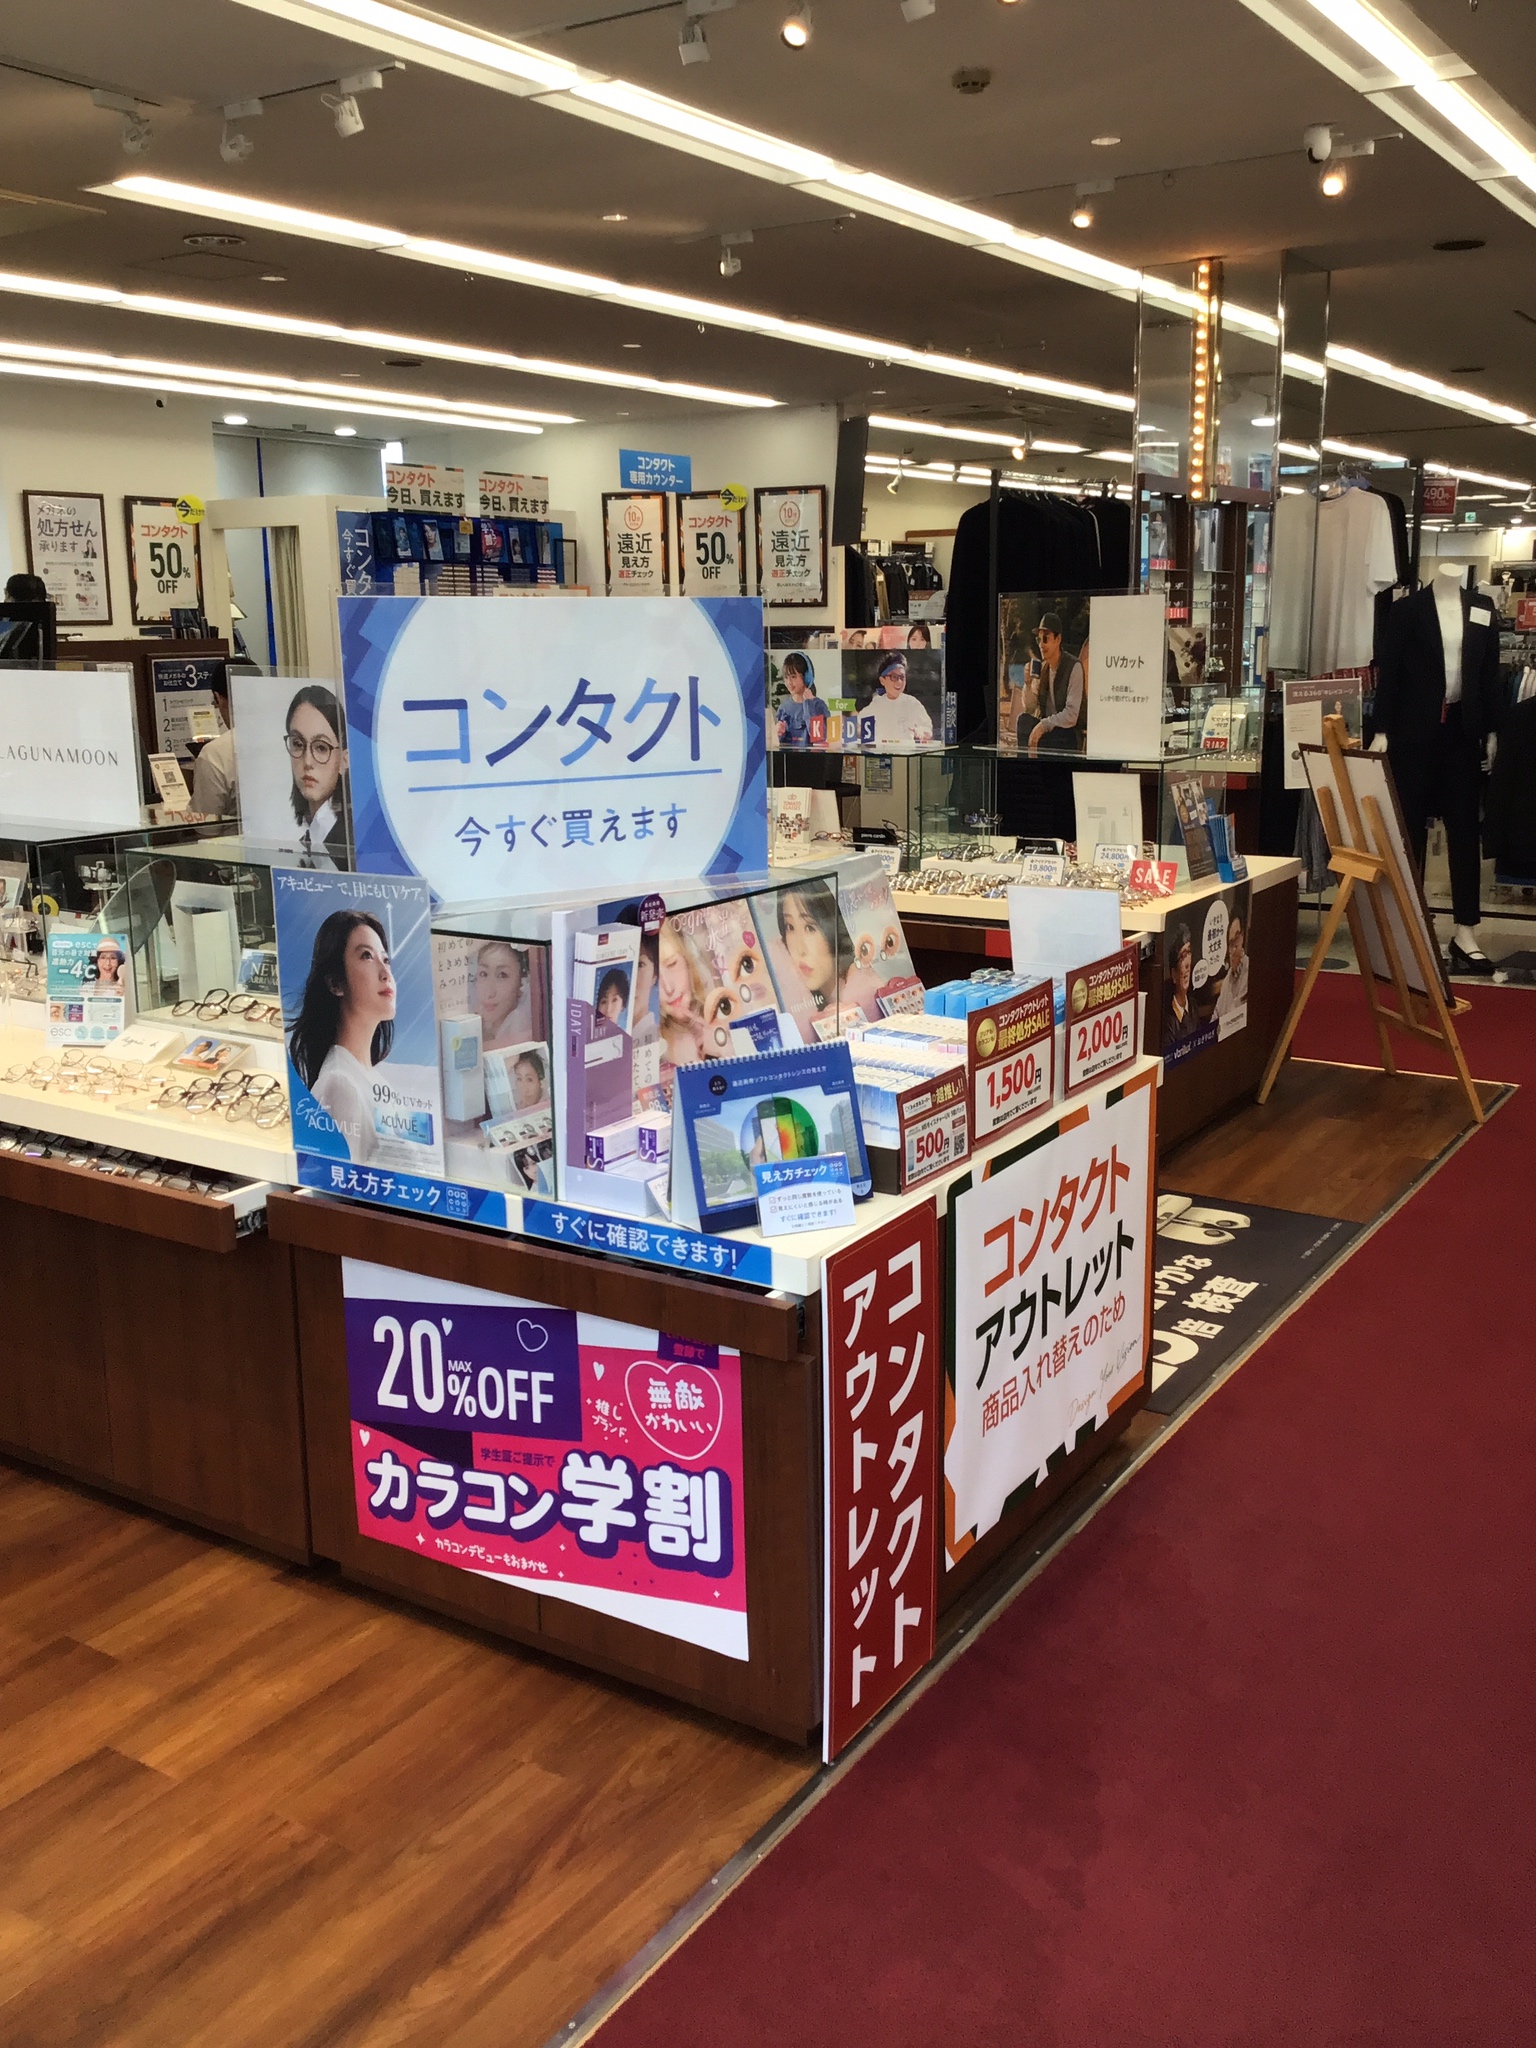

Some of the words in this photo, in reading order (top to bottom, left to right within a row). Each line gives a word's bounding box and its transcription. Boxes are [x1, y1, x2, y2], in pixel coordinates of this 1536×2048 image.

[637, 455, 676, 474] コンタクト
[386, 470, 435, 488] コンタクト
[478, 478, 523, 495] コンタクト
[629, 470, 684, 488] 専用カウンター
[387, 486, 466, 509] 今日、買えます
[480, 494, 549, 515] 今日、買えます
[36, 518, 98, 538] 処方せん
[141, 524, 188, 539] コンタクト
[688, 515, 732, 528] コンタクト
[617, 532, 653, 554] 遠近
[696, 531, 735, 566] 50%
[771, 529, 810, 553] 遠近
[149, 542, 191, 579] 50%
[621, 556, 650, 568] 見え方
[775, 554, 807, 567] 見え方
[702, 566, 721, 580] OFF
[157, 579, 178, 594] OFF
[1105, 655, 1144, 670] UVカット
[835, 700, 848, 710] for
[402, 675, 722, 767] コンタクト
[811, 720, 872, 744] KIDS
[455, 802, 688, 857] 今すぐ買えます
[1134, 864, 1172, 887] SALE
[641, 907, 665, 922] 新発売
[1089, 960, 1133, 987] コンタクトアウトレット
[1088, 972, 1134, 1009] 最終処分SALE
[999, 994, 1049, 1027] コンタクトアウトレット
[998, 1008, 1050, 1051] 最終処分SALE
[1076, 1011, 1128, 1062] 2,000円
[987, 1053, 1042, 1110] 1,500円
[372, 1083, 402, 1106] 99%
[308, 1114, 361, 1138] ACUVUE
[380, 1113, 418, 1134] ACUVUE
[916, 1127, 950, 1163] 500円
[330, 1164, 440, 1206] 見え方チェック
[761, 1164, 828, 1185] 見え方チェック
[984, 1143, 1131, 1299] コンタクト
[551, 1212, 738, 1271] すぐに確認できます!
[975, 1219, 1135, 1391] アウトレット
[447, 1360, 473, 1373] MAX
[982, 1290, 1126, 1438] 商品入れ替えのため
[647, 1376, 705, 1411] 無敵
[595, 1398, 623, 1421] 推し
[592, 1413, 628, 1438] ブランド
[645, 1412, 713, 1434] かわいい
[480, 1447, 555, 1467] 学生証ご提示で
[886, 1240, 925, 1669] コンタクト
[843, 1268, 879, 1710] アウトレット
[366, 1449, 722, 1563] カラコン学割
[435, 1537, 549, 1574] カラコンデビューもおまかせ
